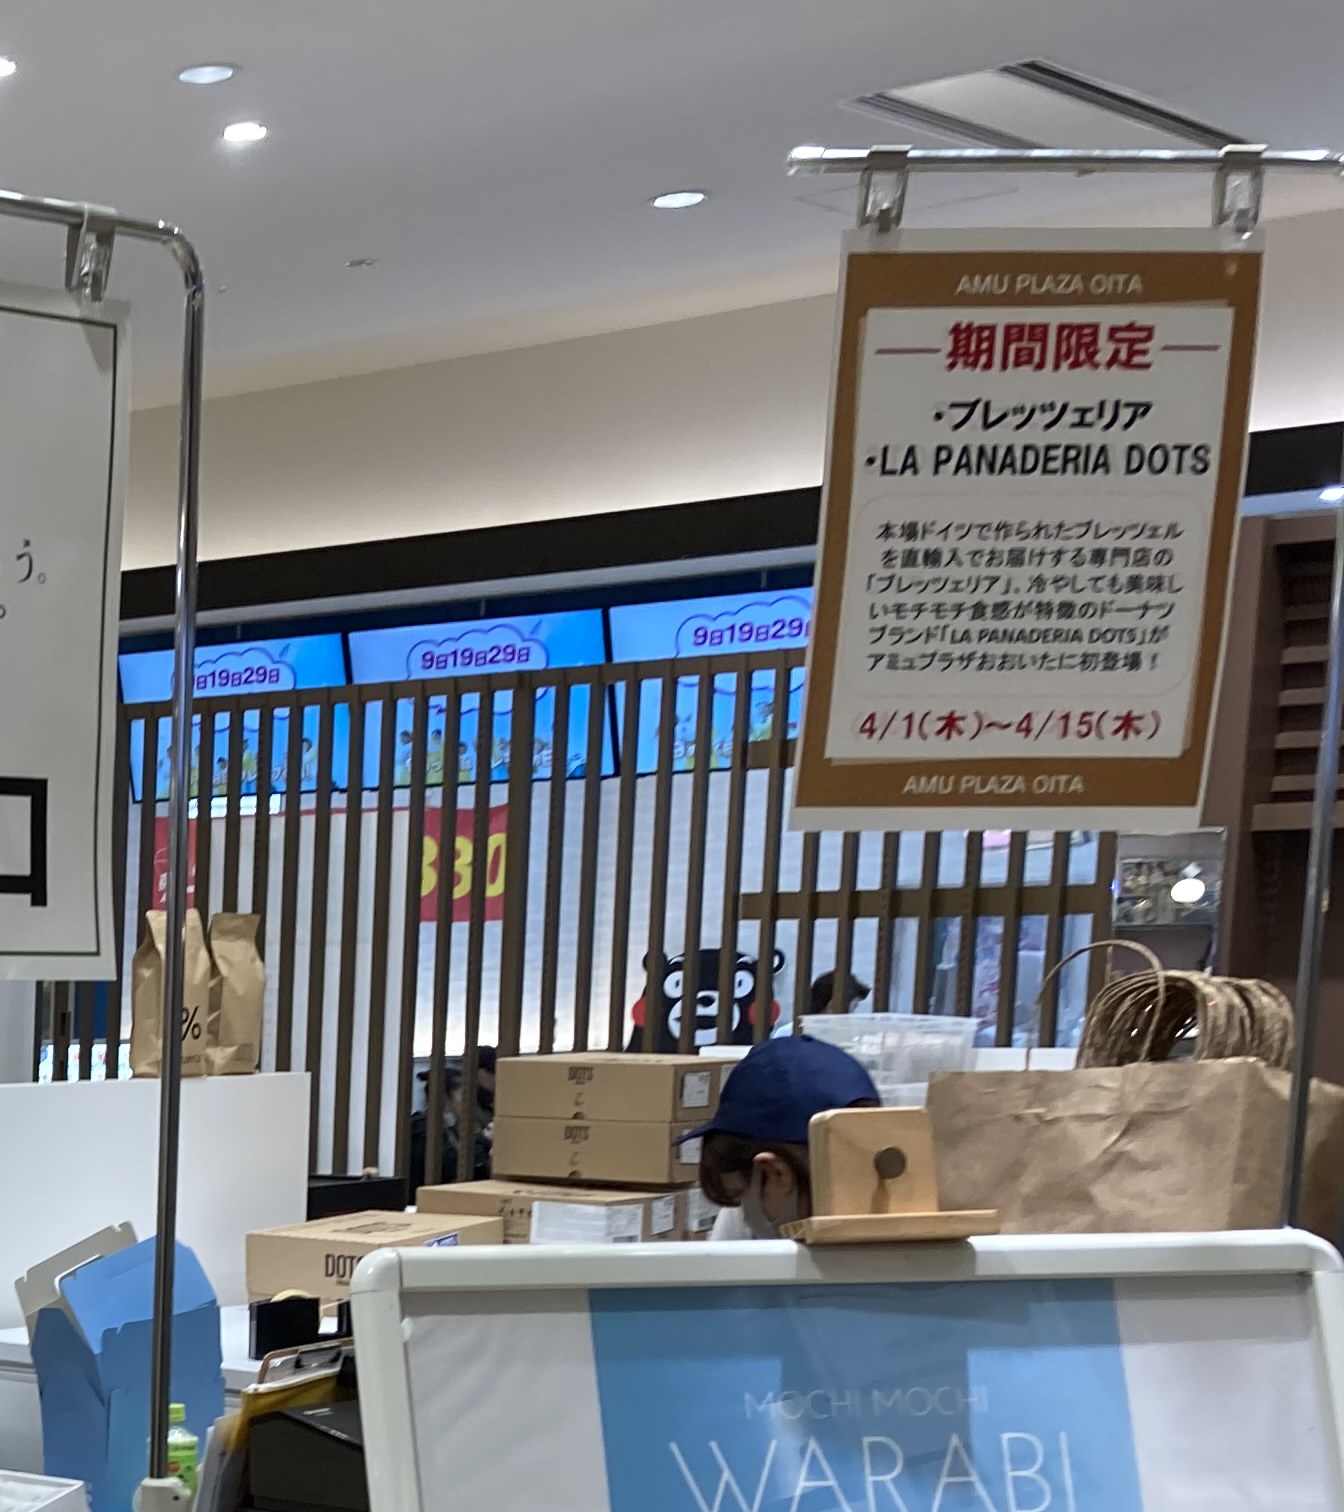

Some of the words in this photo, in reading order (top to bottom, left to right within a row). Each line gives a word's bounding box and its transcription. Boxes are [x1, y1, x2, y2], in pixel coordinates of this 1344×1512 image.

[954, 274, 1010, 296] AMU
[1014, 273, 1084, 295] PLAZA
[1089, 272, 1144, 294] OITA
[944, 320, 1156, 373] 期間限定
[931, 443, 1111, 477] PANADERIA
[1123, 443, 1211, 477] DOTS
[976, 626, 1085, 646] PANADERIA
[193, 665, 281, 691] 日19日29日
[901, 774, 954, 795] AMU
[958, 774, 1027, 795] PLAZA
[1032, 773, 1085, 794] OITA
[568, 1065, 594, 1082] DOTS
[564, 1125, 590, 1142] DOTS
[743, 1388, 865, 1420] MOCHI
[870, 1384, 990, 1418] MOCHI
